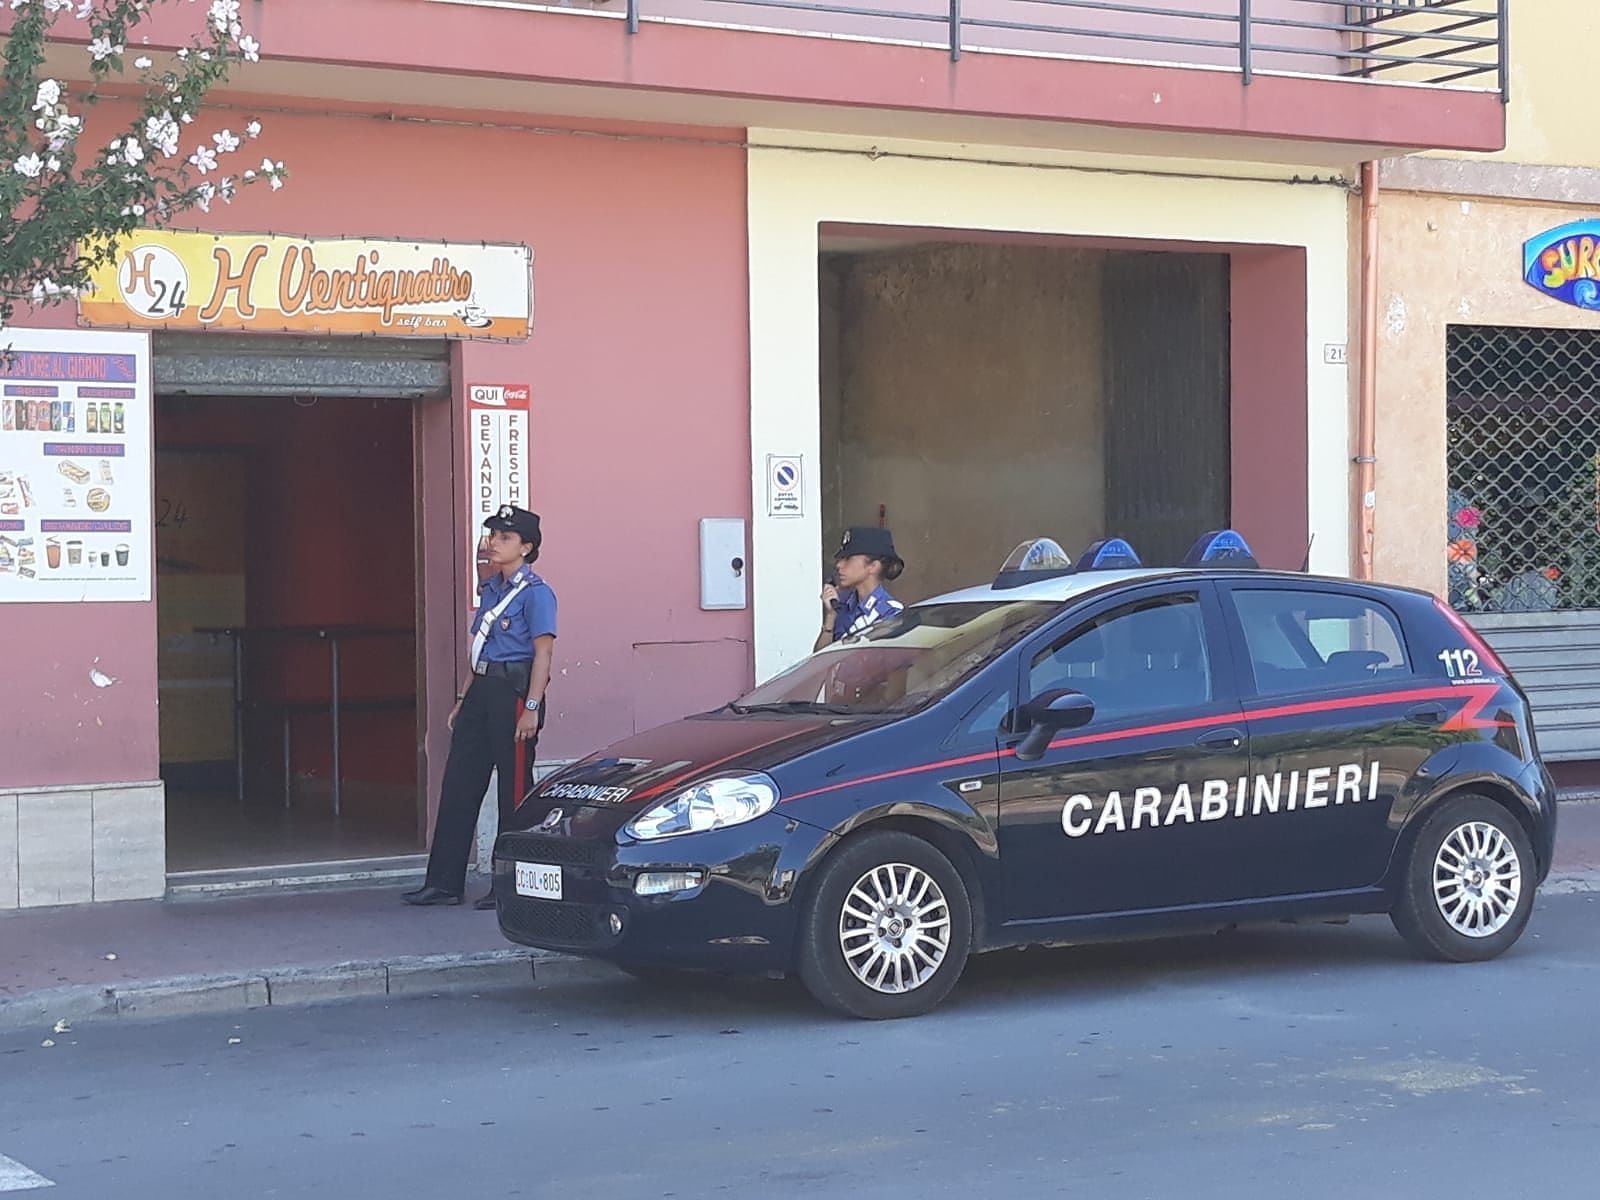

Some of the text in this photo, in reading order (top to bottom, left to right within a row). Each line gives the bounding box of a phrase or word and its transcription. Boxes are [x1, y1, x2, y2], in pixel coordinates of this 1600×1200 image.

[199, 244, 473, 324] H Ventiquattro
[397, 315, 448, 329] self bar
[1330, 348, 1342, 361] 21
[474, 389, 499, 402] QUI
[479, 414, 493, 513] BEVANDE
[1438, 649, 1483, 677] 112
[540, 783, 633, 802] CARABINIERI
[1061, 761, 1379, 838] CARABINIERI
